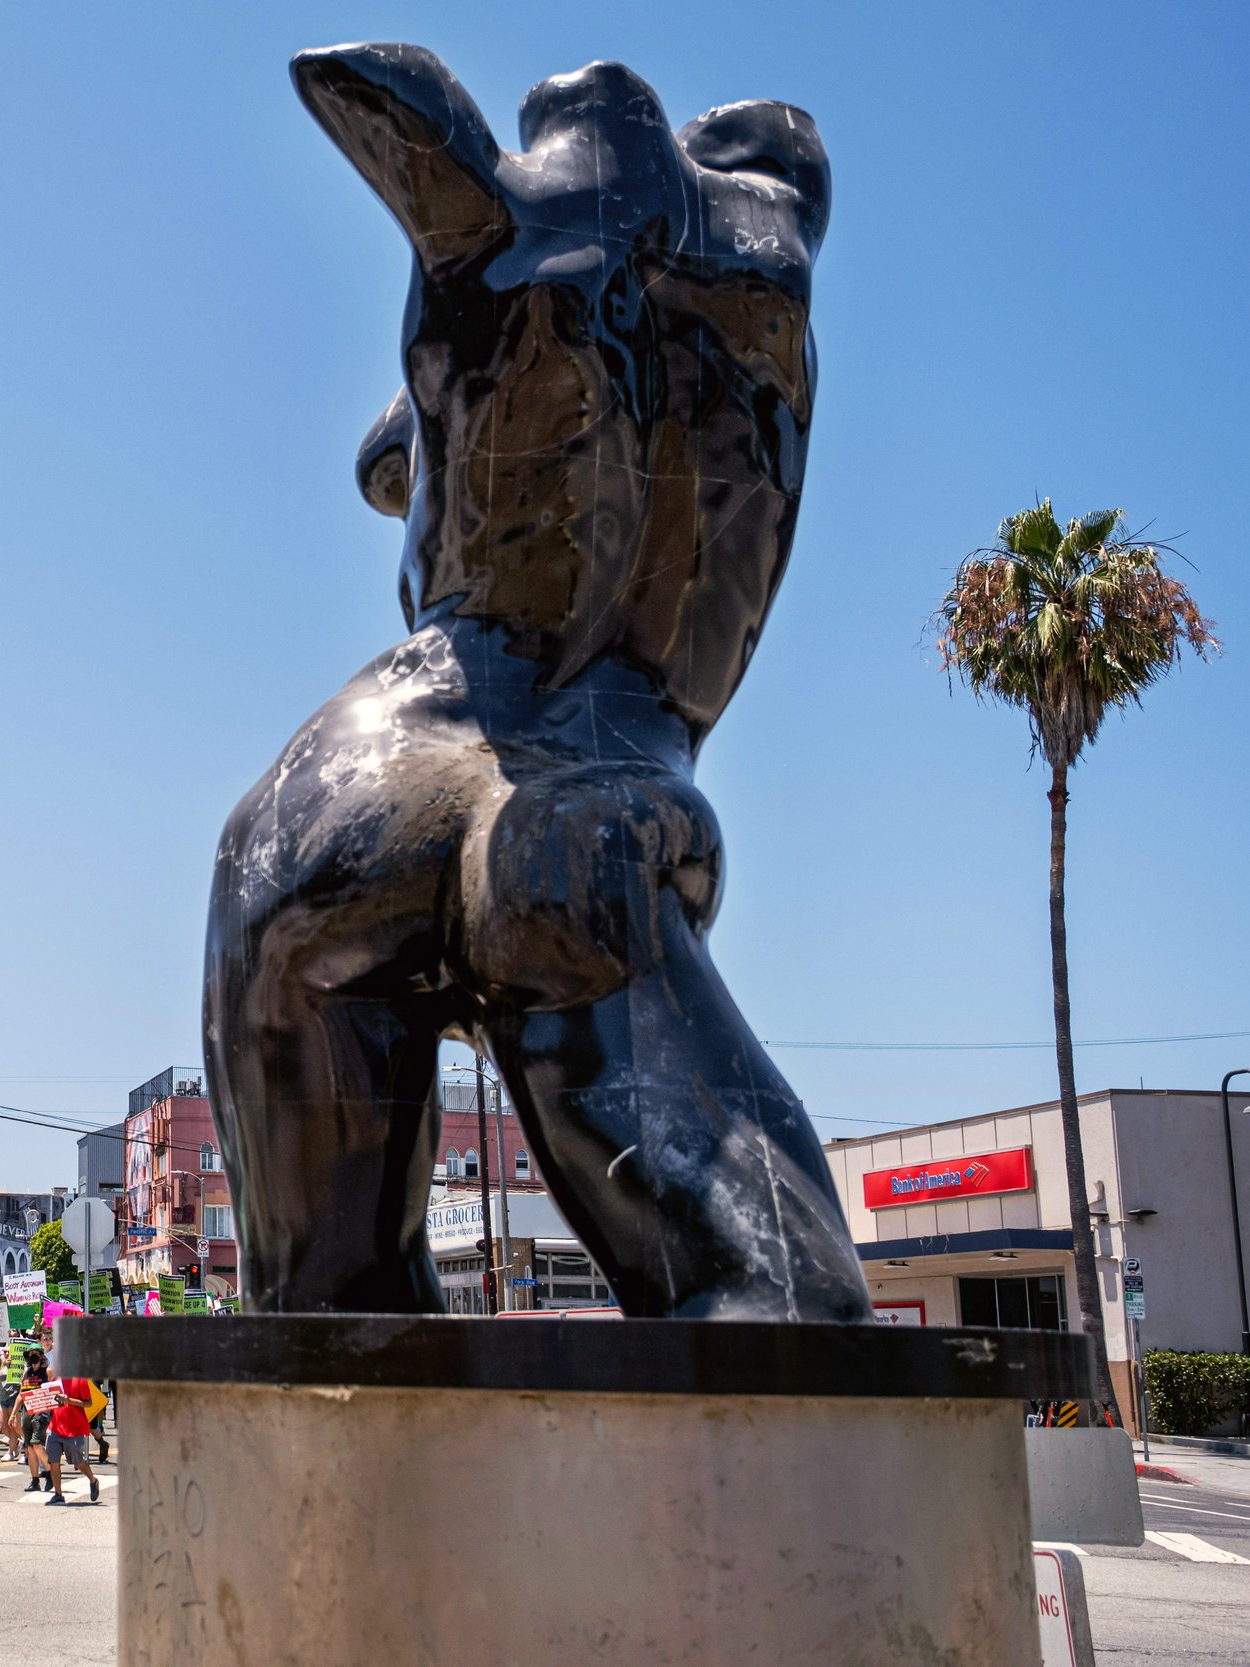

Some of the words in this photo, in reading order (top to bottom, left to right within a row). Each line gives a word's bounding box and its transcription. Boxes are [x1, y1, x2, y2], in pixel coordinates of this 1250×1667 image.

[891, 1174, 915, 1195] Bank
[914, 1172, 924, 1192] of
[925, 1168, 962, 1190] America
[446, 1205, 484, 1226] GROCER
[1037, 1593, 1060, 1618] NG
